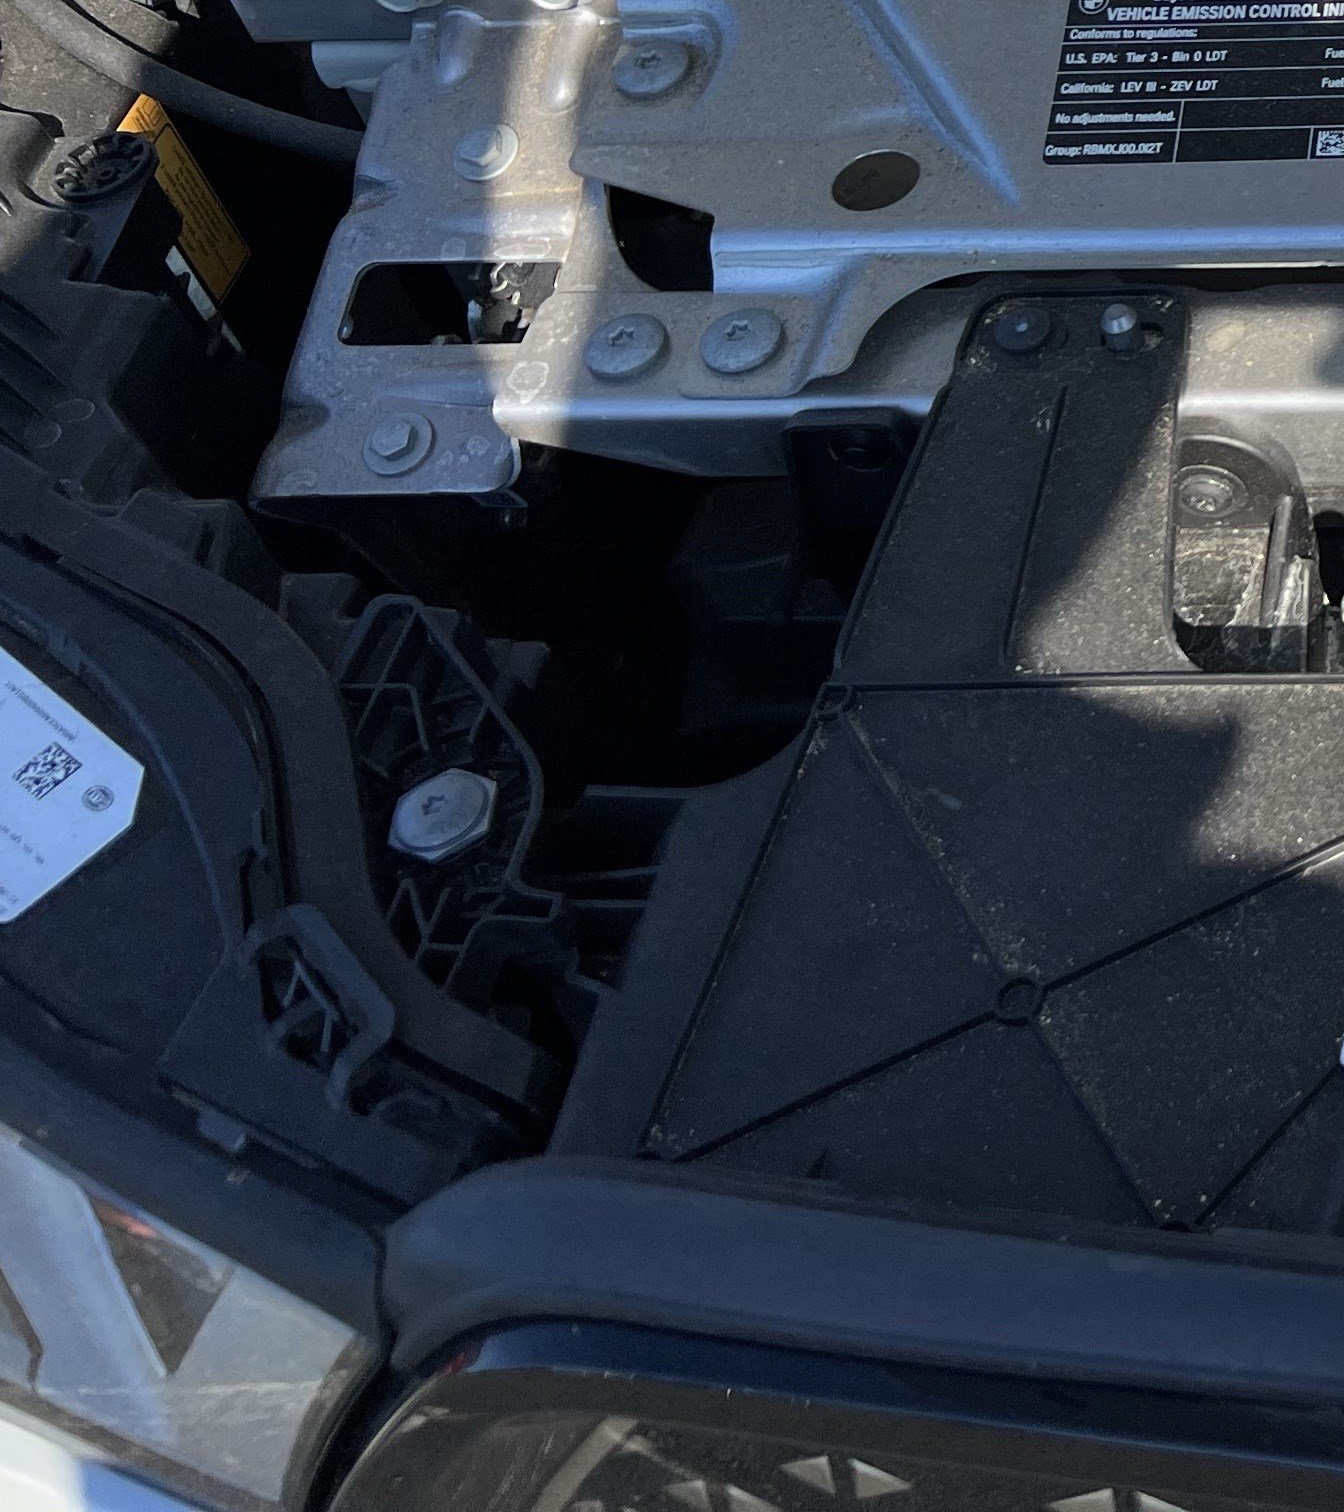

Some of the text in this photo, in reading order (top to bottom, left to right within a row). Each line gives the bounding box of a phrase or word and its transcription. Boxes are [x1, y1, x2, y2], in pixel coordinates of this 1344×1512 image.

[1106, 6, 1170, 22] VEHICLE
[1171, 4, 1247, 21] EMISSION
[1249, 3, 1321, 18] CONTROL
[1069, 28, 1121, 39] Conforms
[1122, 28, 1134, 38] to
[1065, 53, 1088, 65] U.S.
[1126, 51, 1147, 63] Tier
[1149, 51, 1159, 62] 3
[1171, 50, 1190, 62] Bin
[1169, 80, 1193, 92] ZEV
[1055, 112, 1071, 124] No
[1044, 144, 1083, 158] Group:
